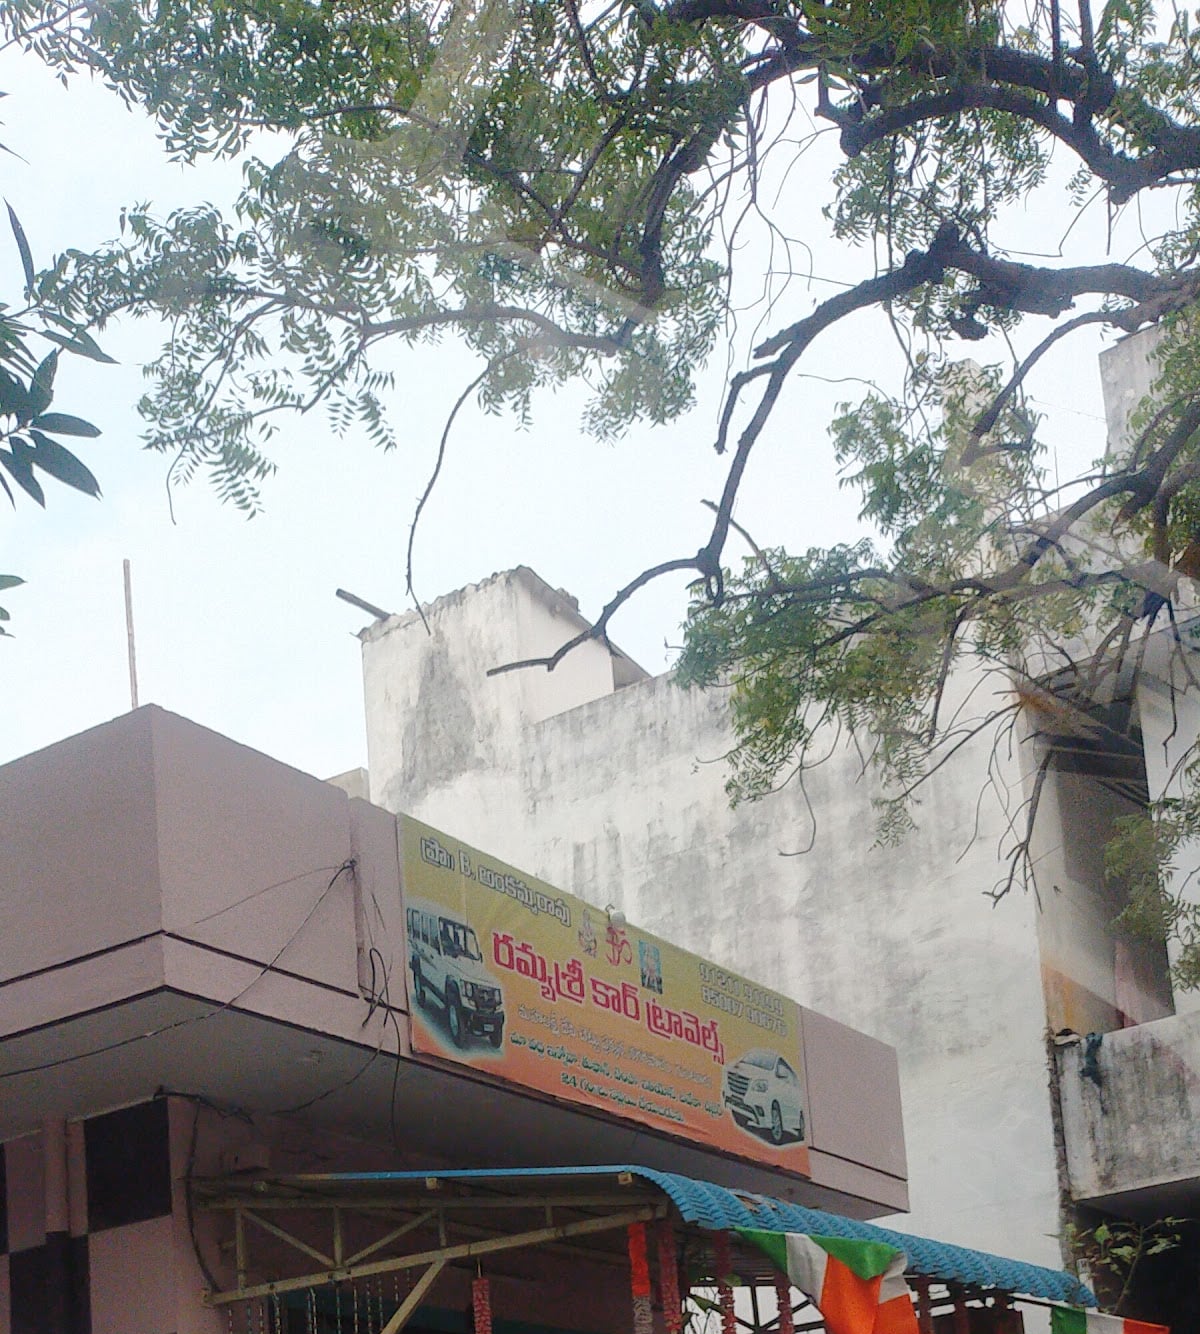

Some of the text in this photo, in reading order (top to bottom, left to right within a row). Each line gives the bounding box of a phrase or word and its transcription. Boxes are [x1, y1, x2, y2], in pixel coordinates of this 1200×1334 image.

[492, 931, 725, 1066] రమ్యశ్రీ కార్ ట్రావెల్స్
[560, 1072, 577, 1088] 24
